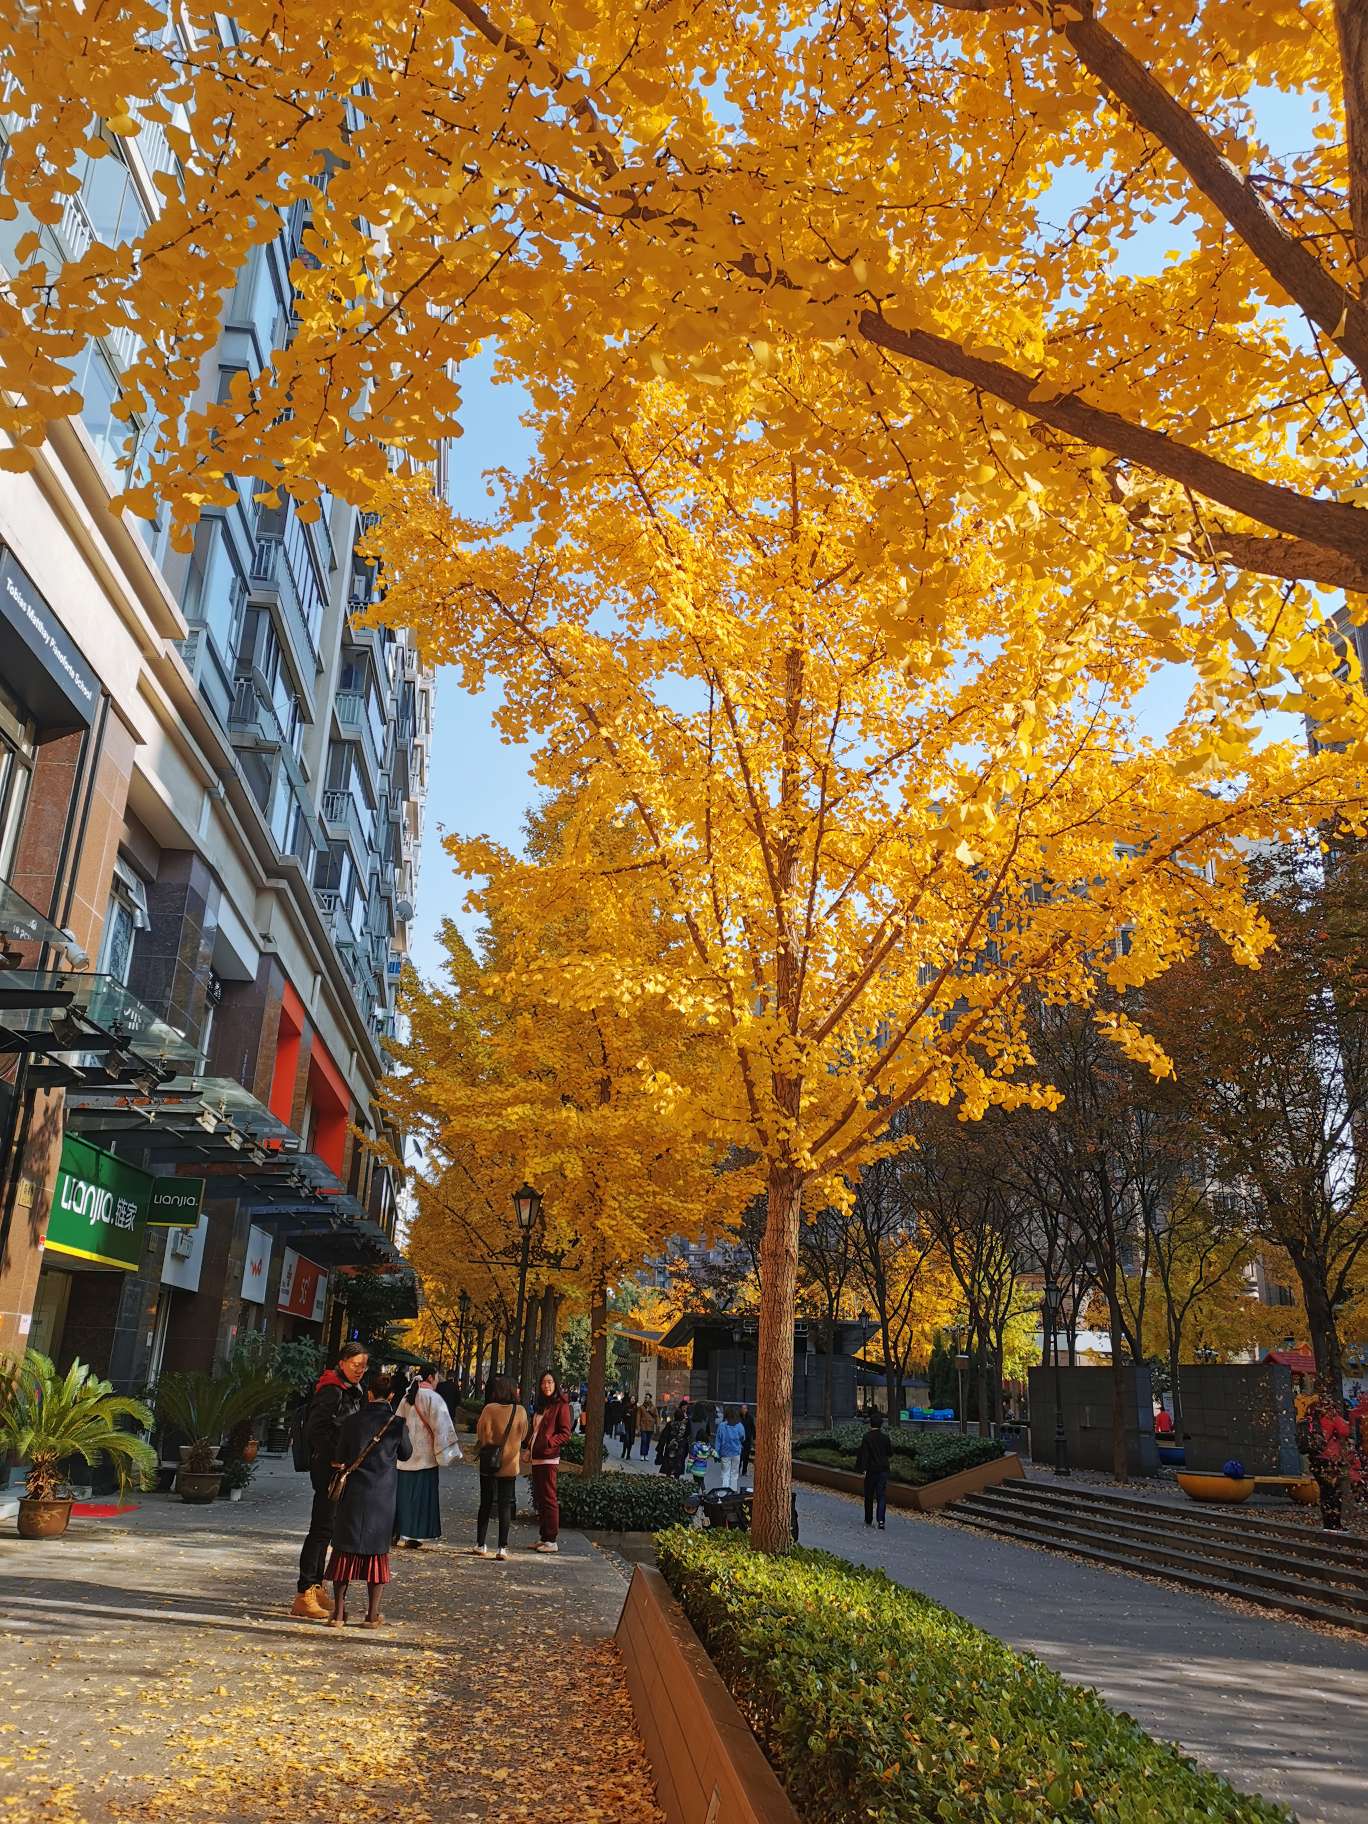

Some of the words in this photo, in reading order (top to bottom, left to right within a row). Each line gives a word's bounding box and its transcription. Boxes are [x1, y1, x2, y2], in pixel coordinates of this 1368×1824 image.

[7, 577, 27, 611] Tobias
[27, 605, 50, 644] Matthay
[50, 637, 75, 679] Pianoforte
[75, 673, 92, 702] School
[115, 1197, 137, 1231] 链家
